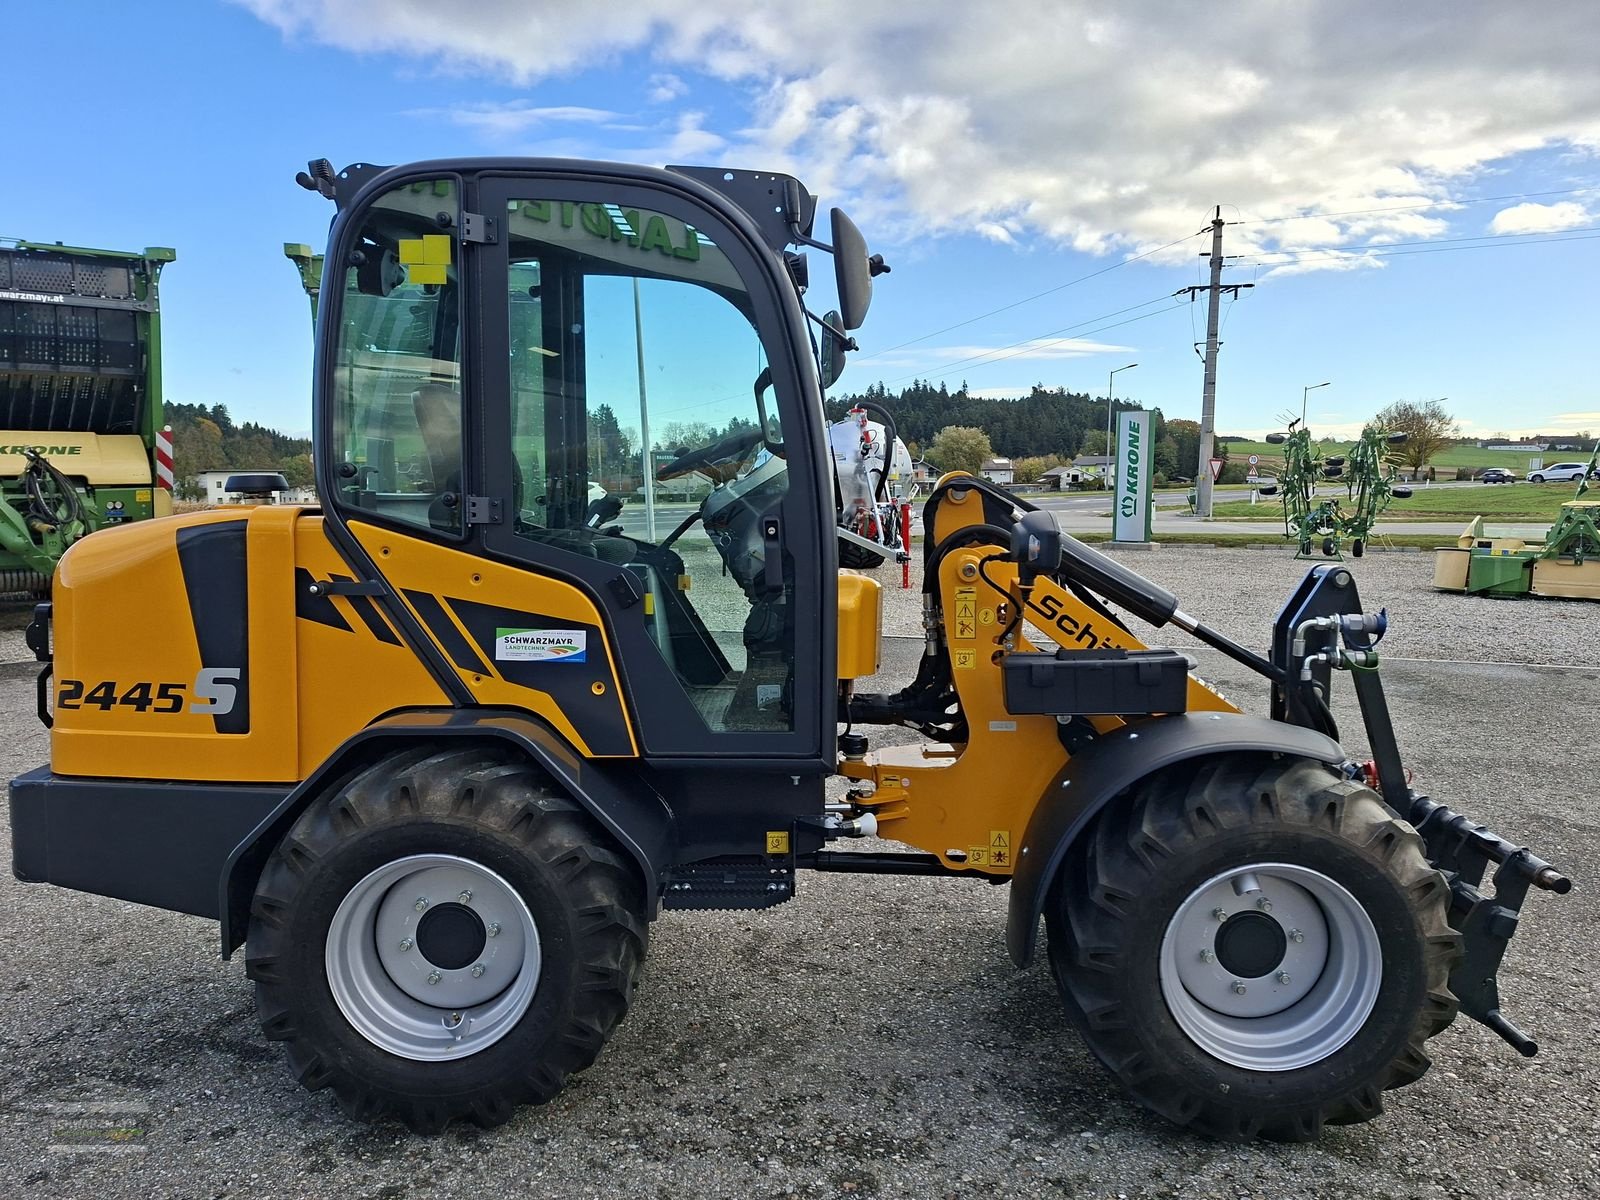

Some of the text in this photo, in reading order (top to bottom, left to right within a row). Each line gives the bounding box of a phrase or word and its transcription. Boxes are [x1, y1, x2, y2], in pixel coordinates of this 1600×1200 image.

[1126, 420, 1140, 495] KRONE
[504, 636, 573, 645] SCHWARZMAYR
[1025, 594, 1124, 650] Sch
